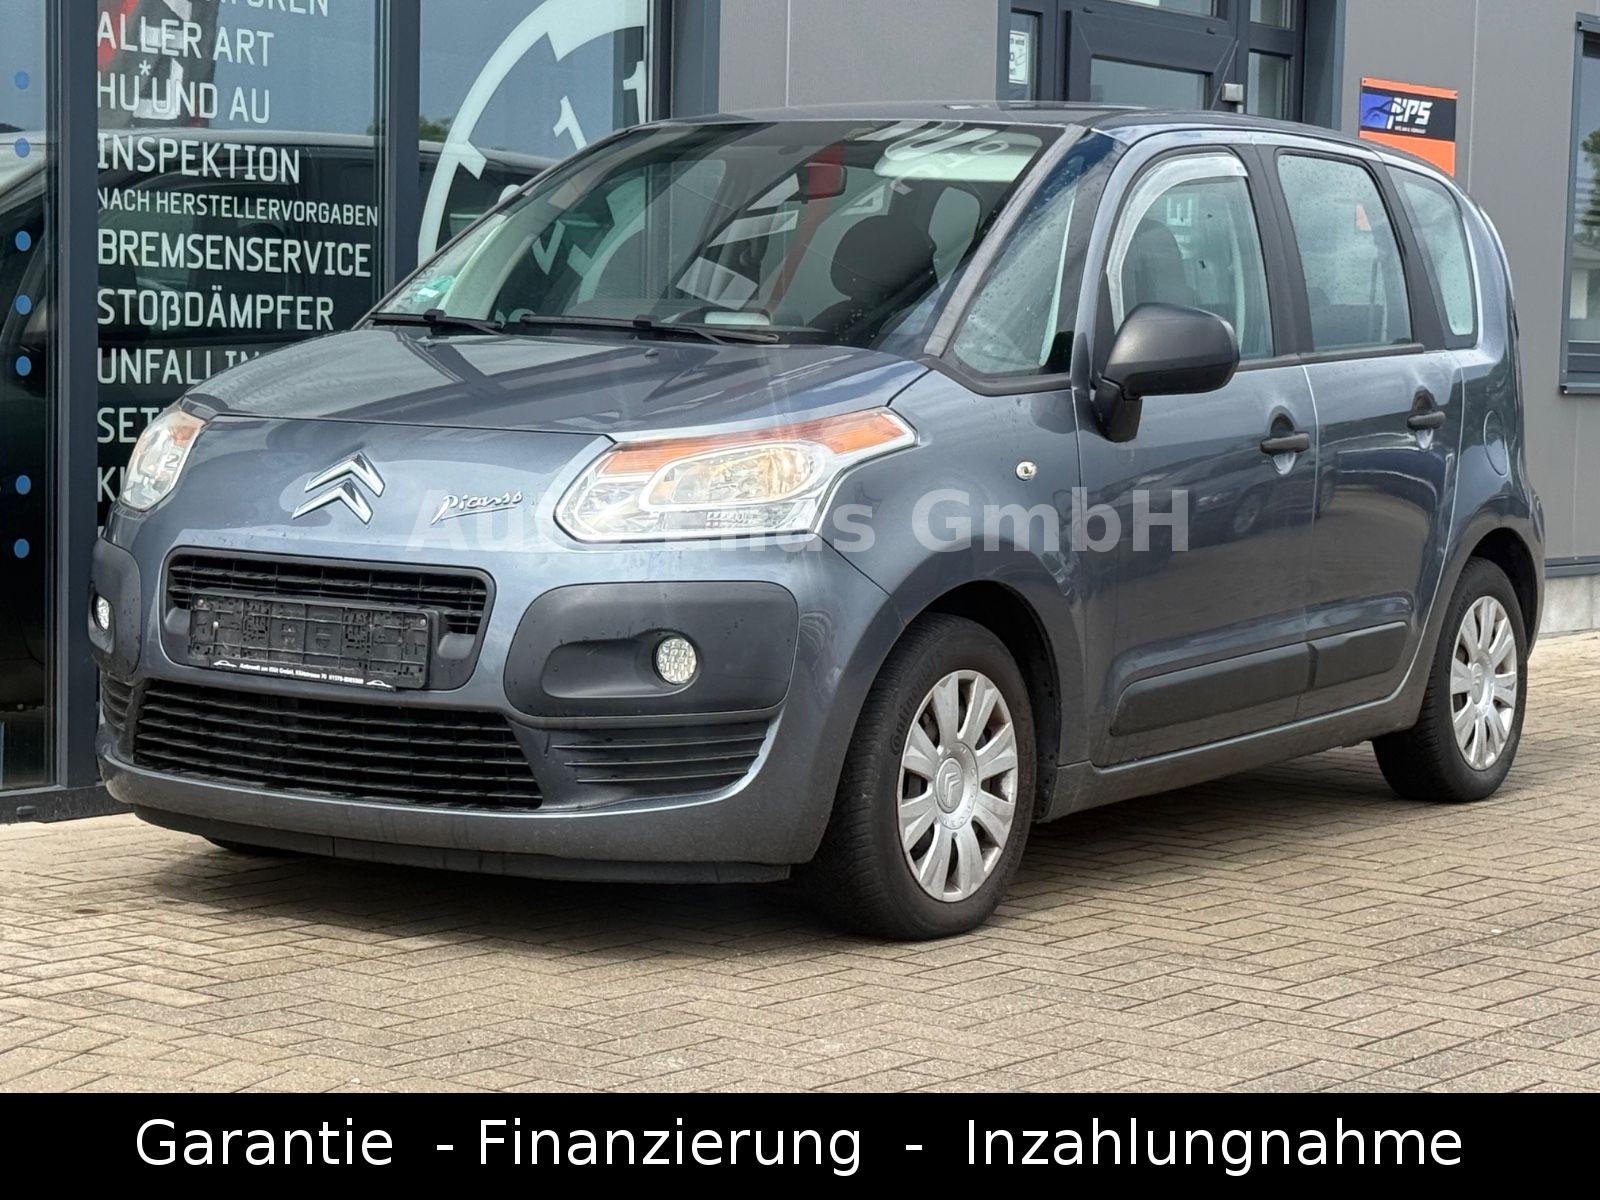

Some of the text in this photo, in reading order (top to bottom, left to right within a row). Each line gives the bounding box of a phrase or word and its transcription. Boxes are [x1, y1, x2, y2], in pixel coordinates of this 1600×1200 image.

[98, 11, 274, 67] ALLER ART
[152, 76, 218, 119] UND
[229, 86, 270, 124] AU
[98, 133, 300, 184] INSPEKTION
[98, 187, 378, 227] NACH HERSTELLERVORGABEN
[98, 228, 372, 278] BREMSENSERVICE
[430, 490, 524, 526] Picasso
